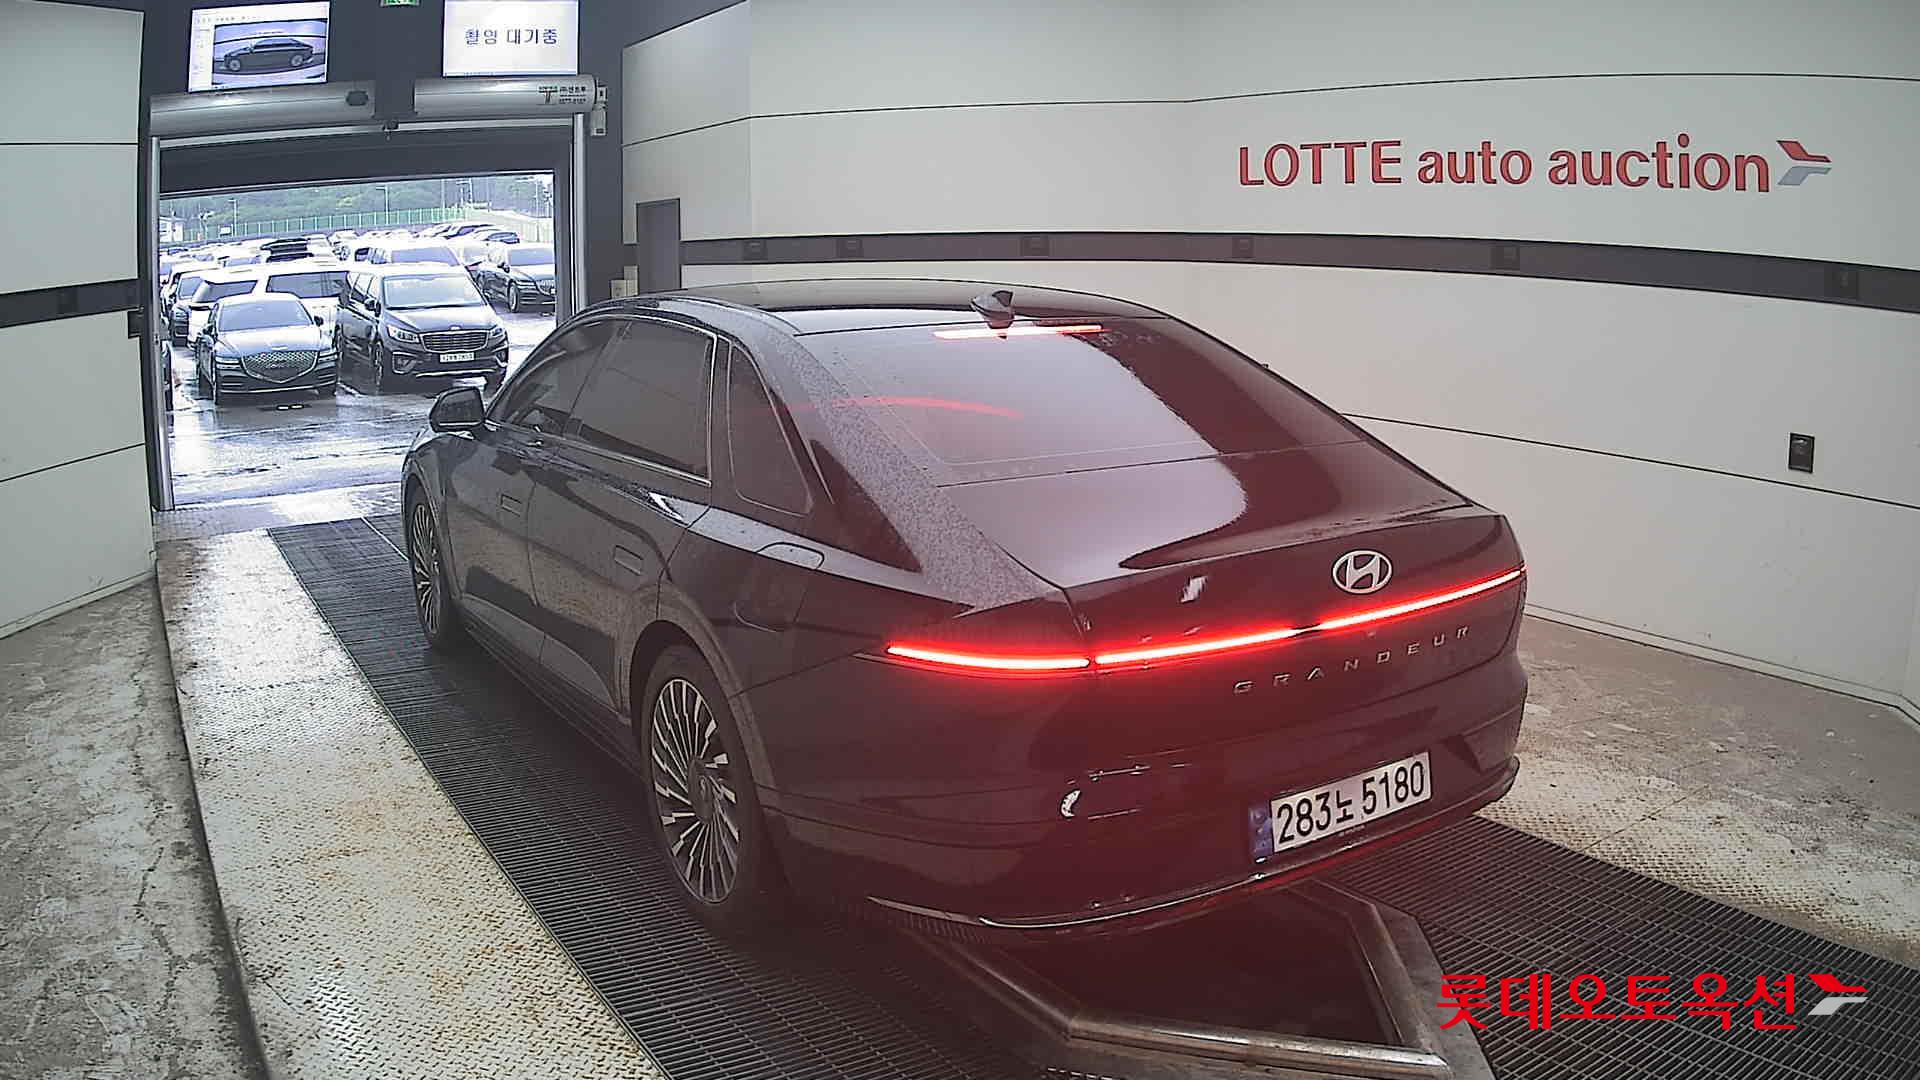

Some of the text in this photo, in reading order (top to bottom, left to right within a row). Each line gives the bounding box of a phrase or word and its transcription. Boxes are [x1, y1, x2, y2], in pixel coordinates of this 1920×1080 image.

[465, 28, 558, 45] 촬영 대기중
[1238, 133, 1770, 193] LOTTE auto auction
[1233, 625, 1470, 694] GRANDEUR
[1277, 761, 1425, 844] 283노 5180
